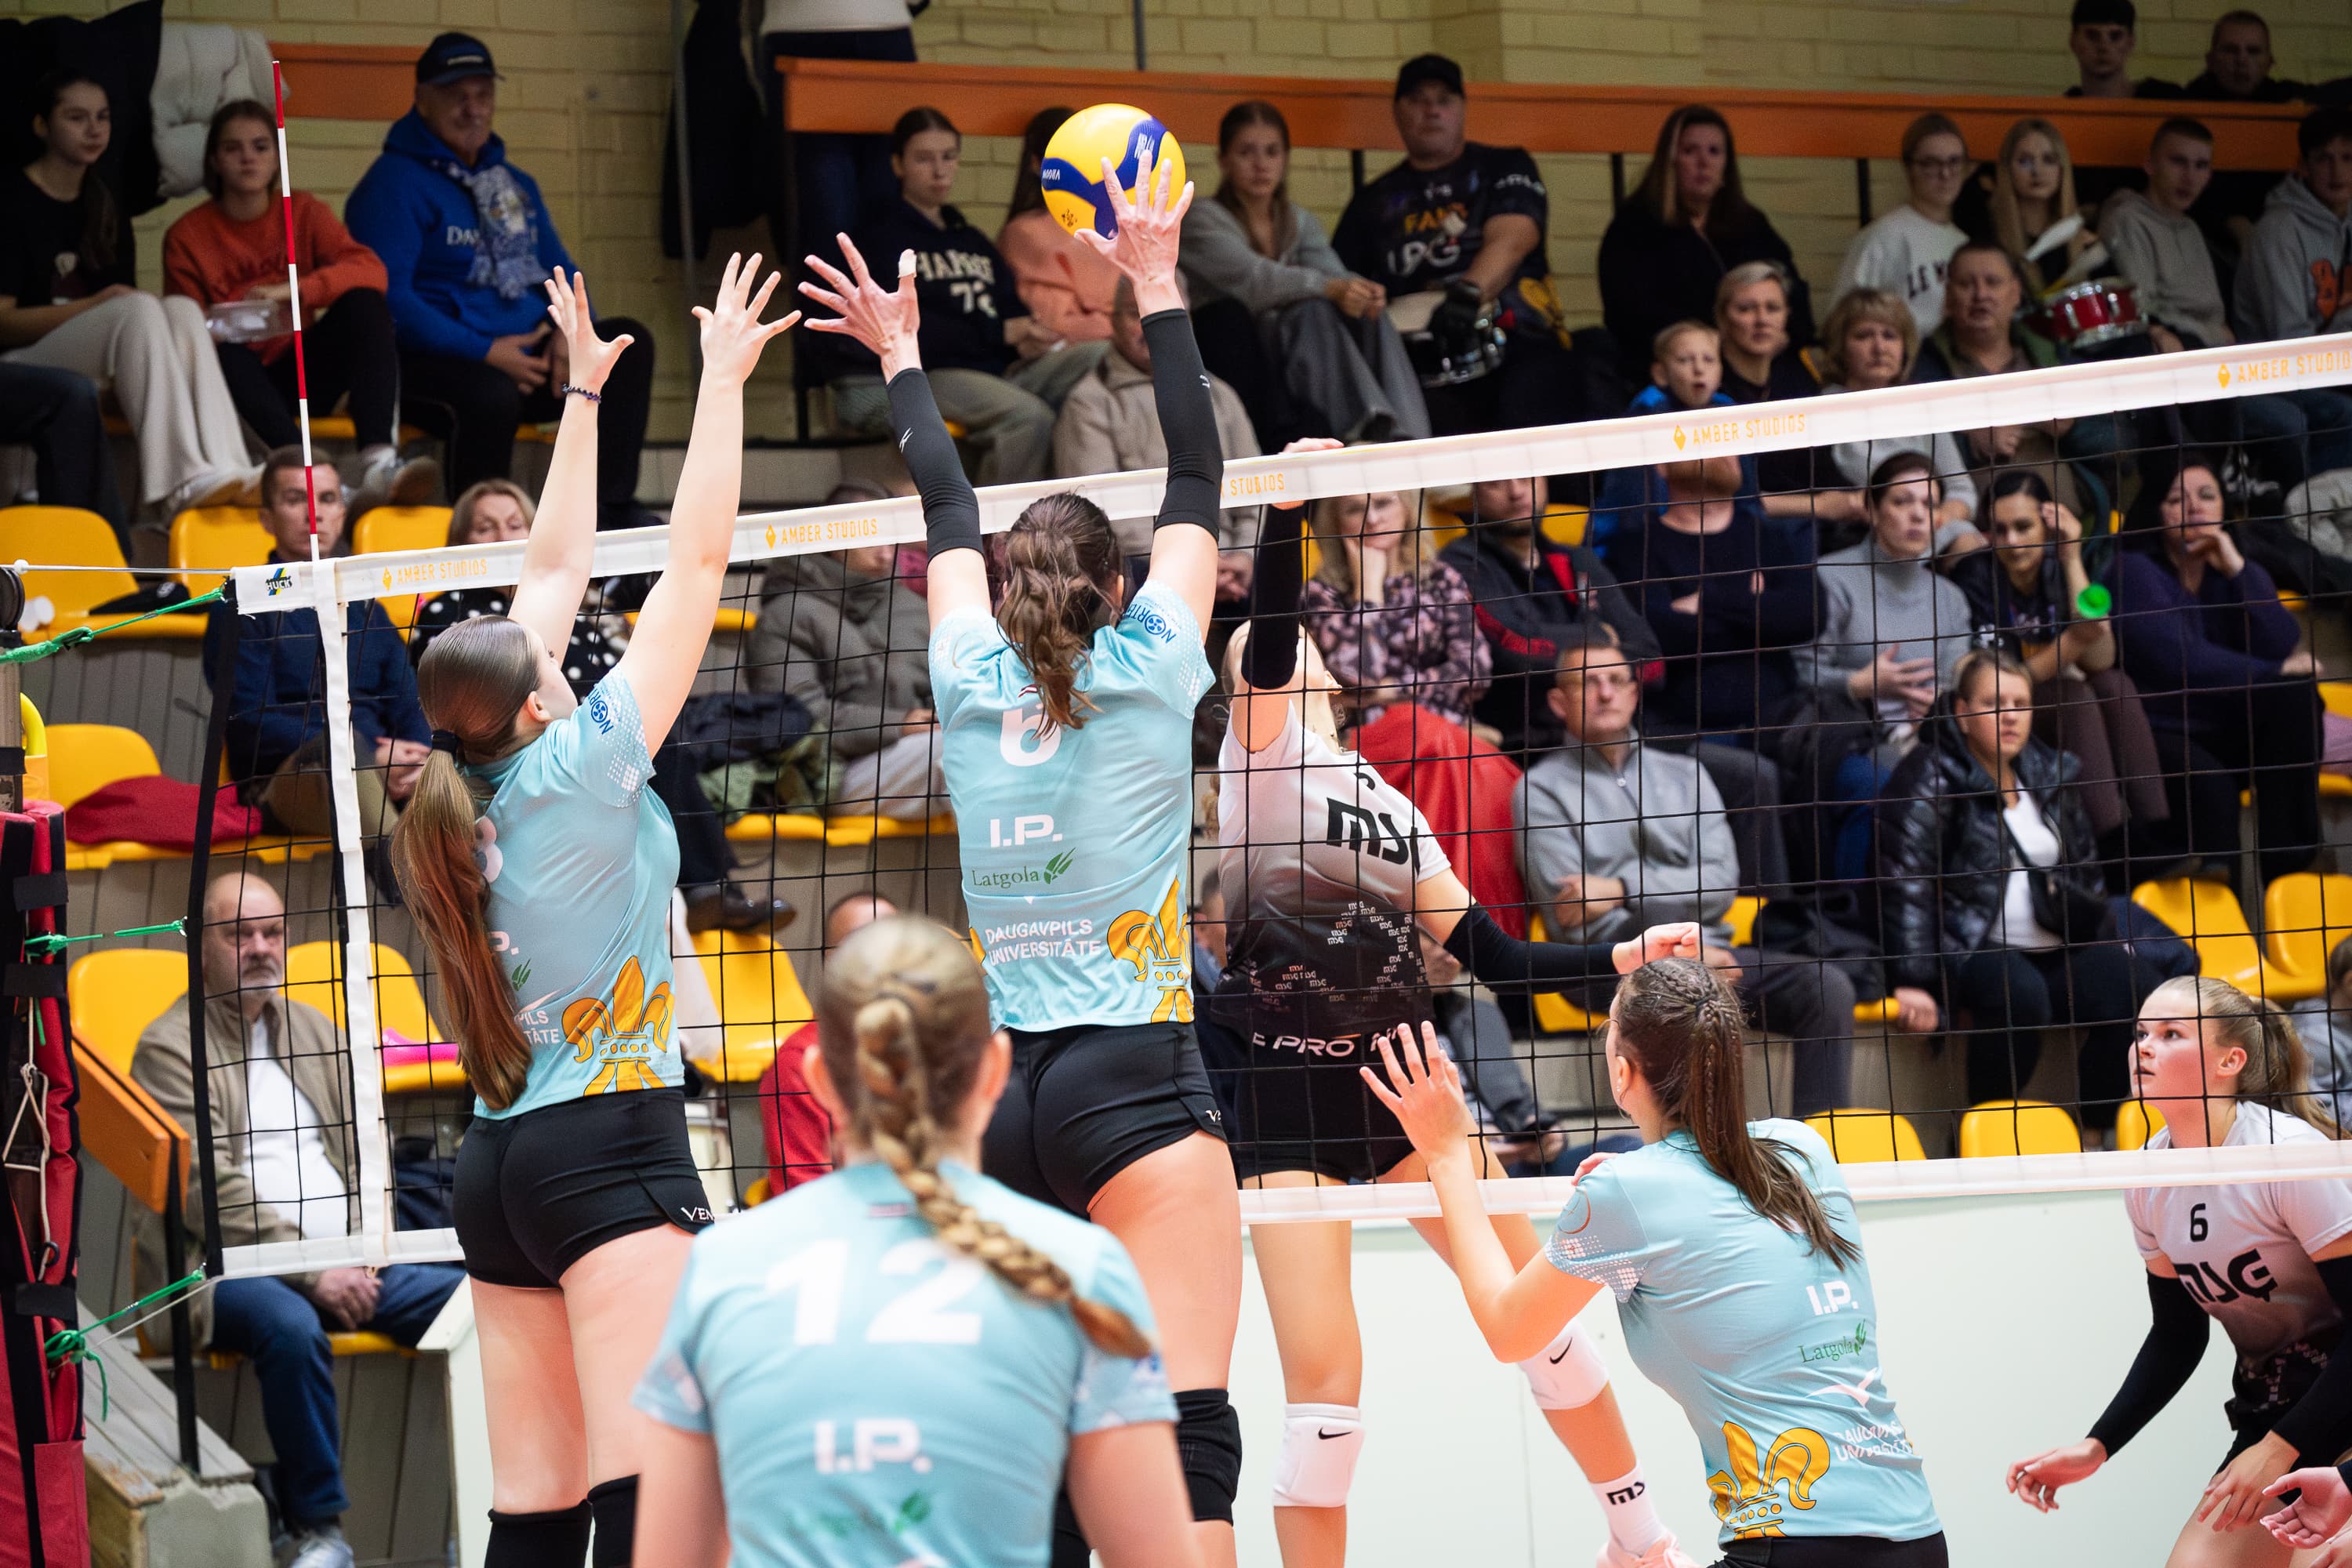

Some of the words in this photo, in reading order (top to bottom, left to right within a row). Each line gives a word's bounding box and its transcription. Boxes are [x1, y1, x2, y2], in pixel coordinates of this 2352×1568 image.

[2238, 358, 2289, 383] AMBER
[2297, 351, 2351, 375] STUDIO
[1693, 423, 1740, 446] AMBER
[1745, 414, 1806, 438] STUDIOS
[1230, 472, 1285, 496] STUDIOS
[781, 524, 822, 544] AMBER
[827, 518, 877, 539] STUDIOS
[397, 564, 435, 585] AMBER
[440, 558, 487, 579] STUDIOS
[990, 814, 1063, 848] I.P.
[971, 866, 1040, 889] Latgola
[985, 919, 1093, 945] DAUGAVPILS
[989, 938, 1102, 967] UNIVERSITĀTE
[1272, 1035, 1355, 1057] PRO
[2190, 1203, 2208, 1242] 6
[765, 1237, 983, 1345] 12
[1806, 1280, 1859, 1316] I.P.
[1798, 1336, 1853, 1363] Latgola
[815, 1418, 933, 1474] I.P.
